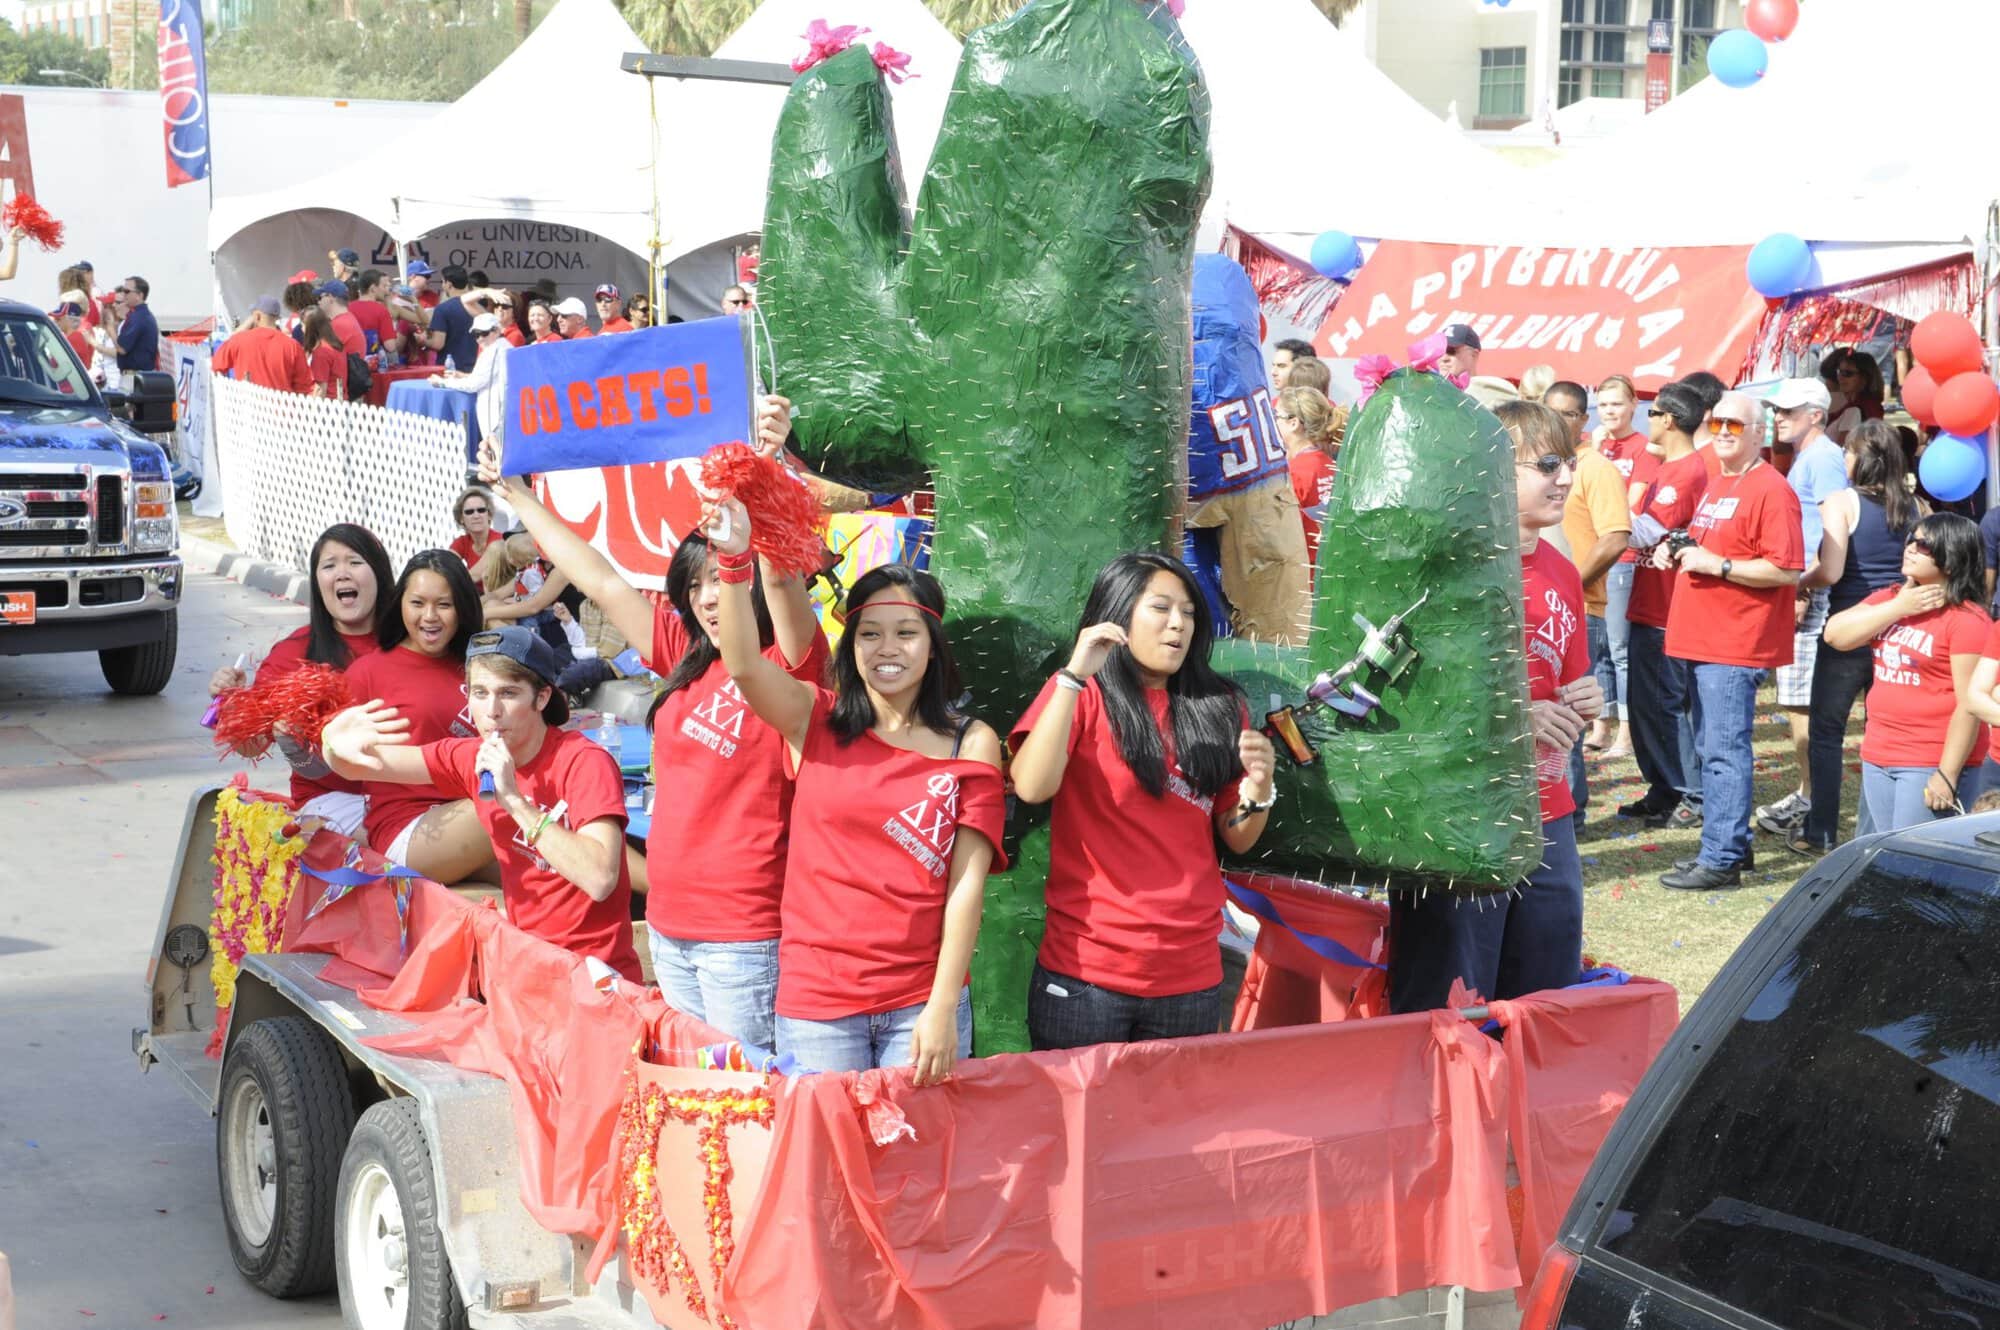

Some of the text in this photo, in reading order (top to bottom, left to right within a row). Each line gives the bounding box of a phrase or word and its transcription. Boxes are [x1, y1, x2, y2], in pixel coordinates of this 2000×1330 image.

[448, 247, 585, 270] OF ARIZONA
[519, 362, 712, 435] GO CATS!
